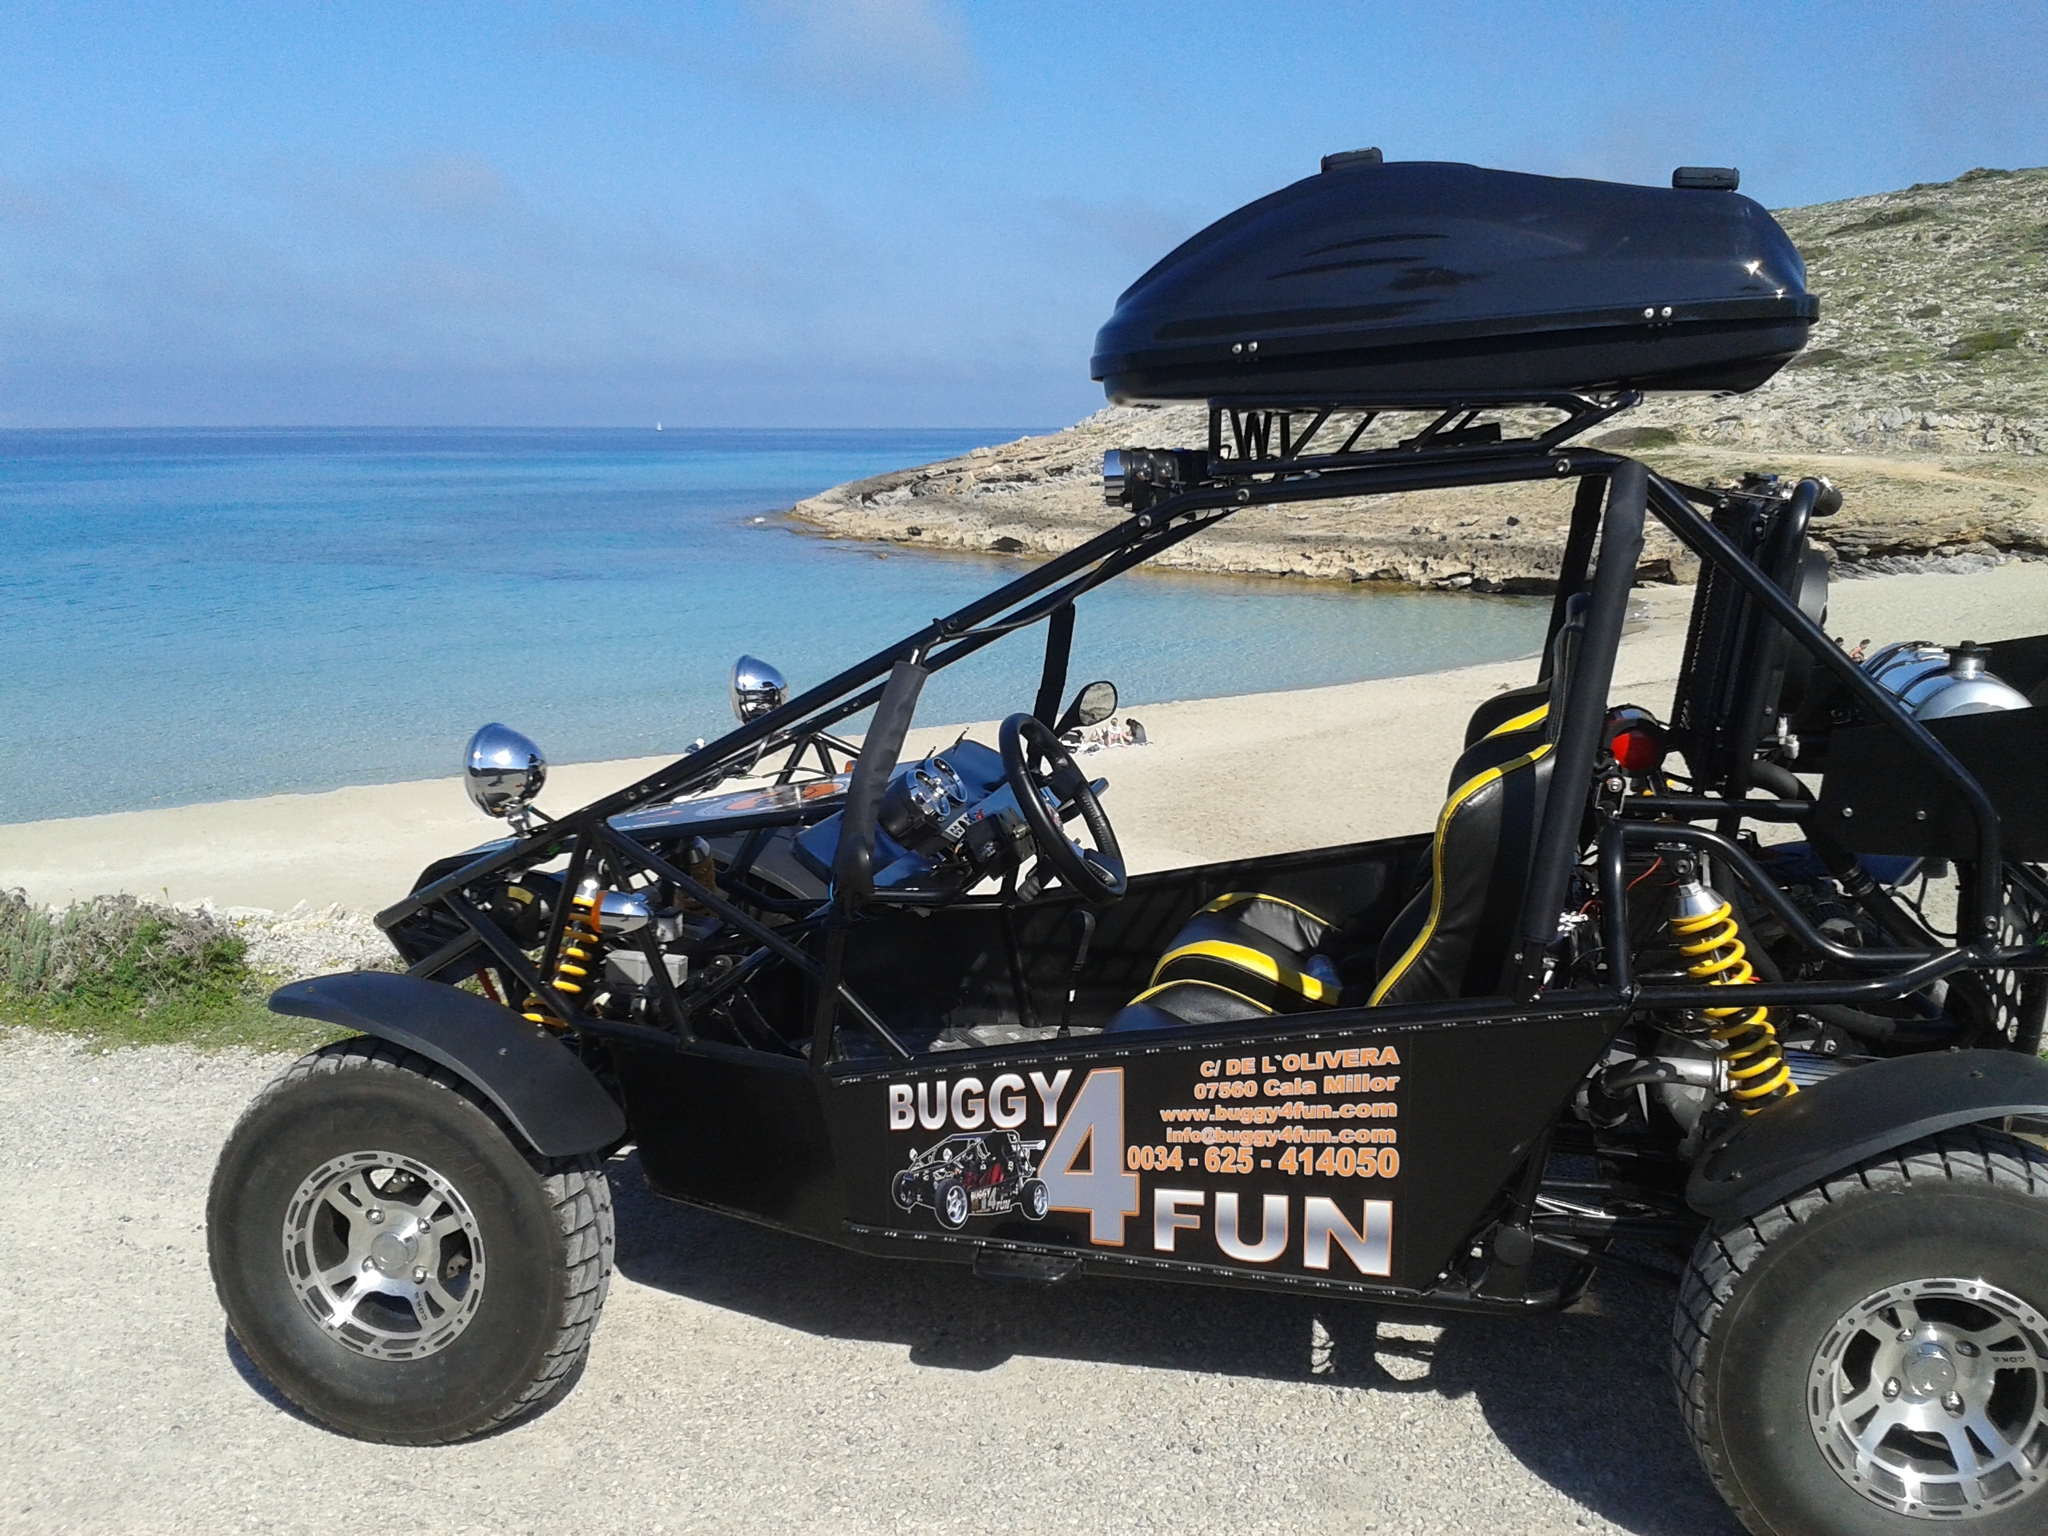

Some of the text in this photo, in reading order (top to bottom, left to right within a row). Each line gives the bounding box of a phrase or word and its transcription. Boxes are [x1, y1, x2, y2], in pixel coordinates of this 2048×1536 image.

[1200, 1061, 1220, 1078] C/
[1226, 1057, 1255, 1076] DE
[1194, 1074, 1400, 1100] 07560 Cala Millor
[1160, 1102, 1397, 1124] www.buggy4fun.com
[1166, 1126, 1397, 1147] info@buggy4fun.com
[889, 1067, 1140, 1246] BUGGY 4
[1127, 1146, 1183, 1171] 0034
[1204, 1146, 1254, 1173] 625
[1278, 1147, 1400, 1178] 414050
[1154, 1188, 1393, 1277] FUN
